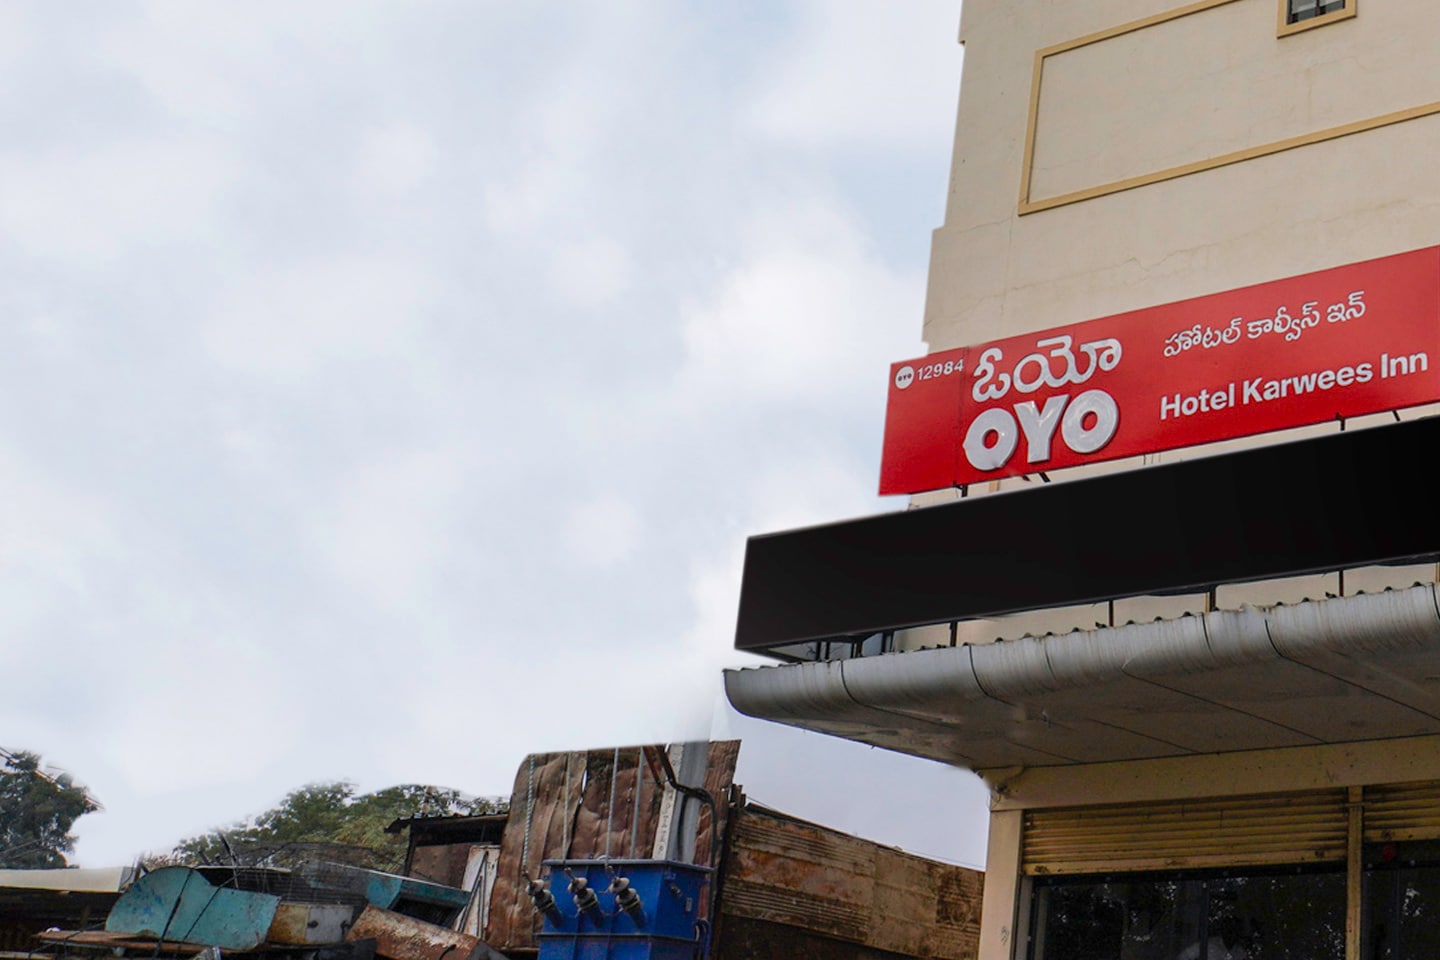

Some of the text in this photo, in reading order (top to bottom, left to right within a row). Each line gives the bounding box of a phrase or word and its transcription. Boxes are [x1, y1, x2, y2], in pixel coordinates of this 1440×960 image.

[1163, 317, 1243, 357] హోటల్
[1326, 290, 1367, 324] ఇన్
[917, 358, 964, 381] 12984
[971, 334, 1123, 403] ఓయో
[1160, 351, 1428, 420] Hotel Karwees Inn
[963, 389, 1120, 471] OYO
